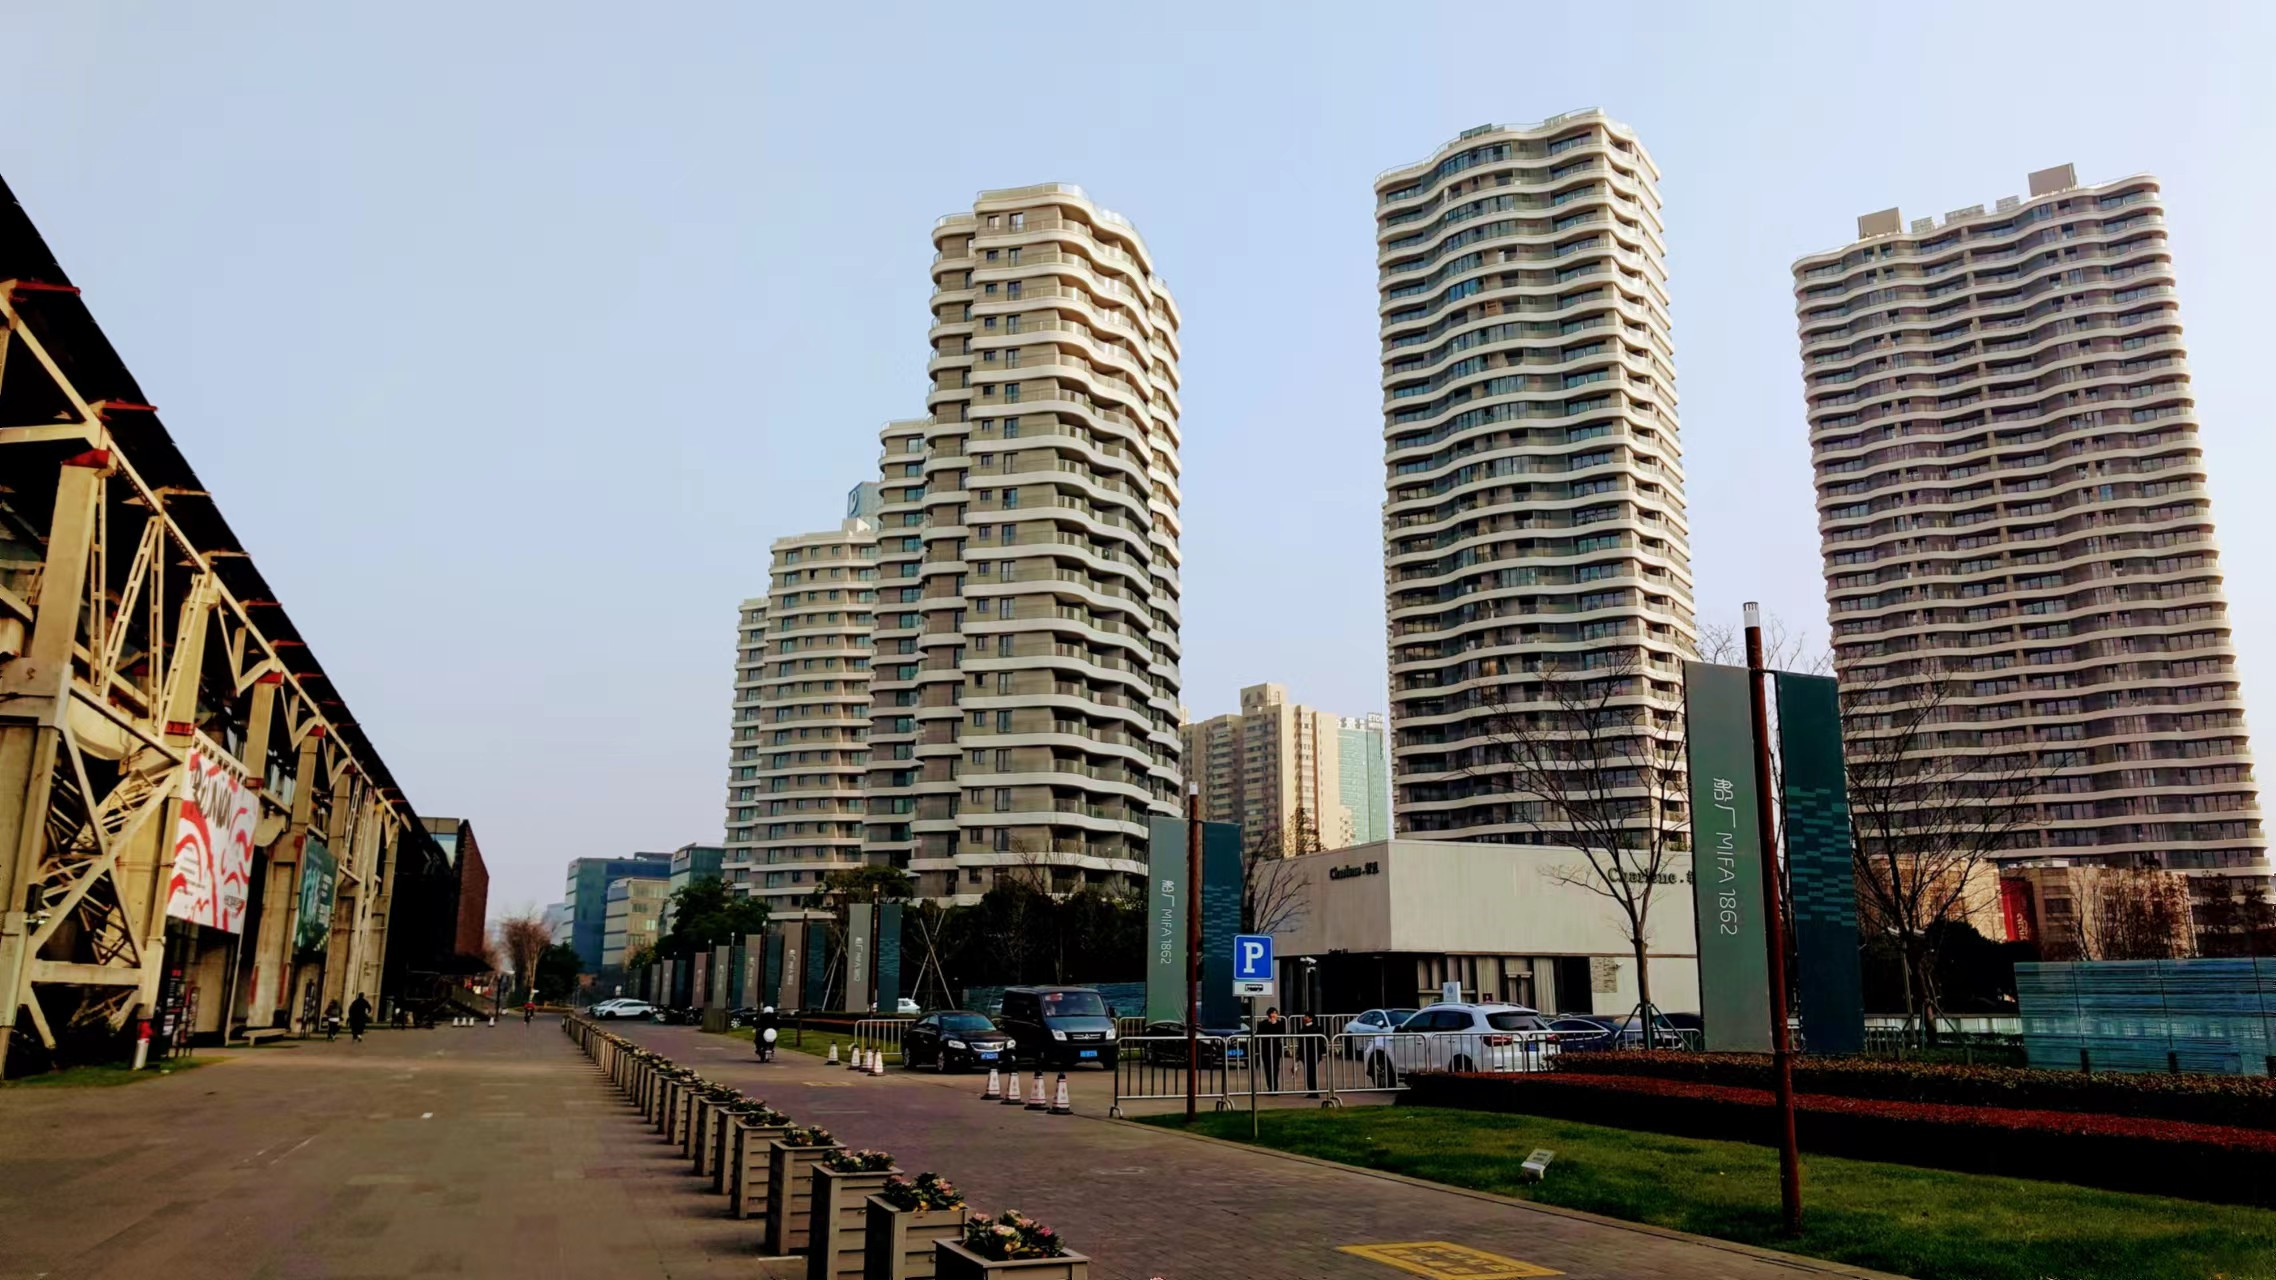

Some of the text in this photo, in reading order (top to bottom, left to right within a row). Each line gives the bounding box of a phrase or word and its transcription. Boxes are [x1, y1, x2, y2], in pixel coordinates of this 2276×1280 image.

[1713, 777, 1738, 935] 船厂 MIFA 1862
[1161, 908, 1173, 937] MIFA
[1160, 939, 1172, 964] 1862
[1243, 941, 1264, 973] P
